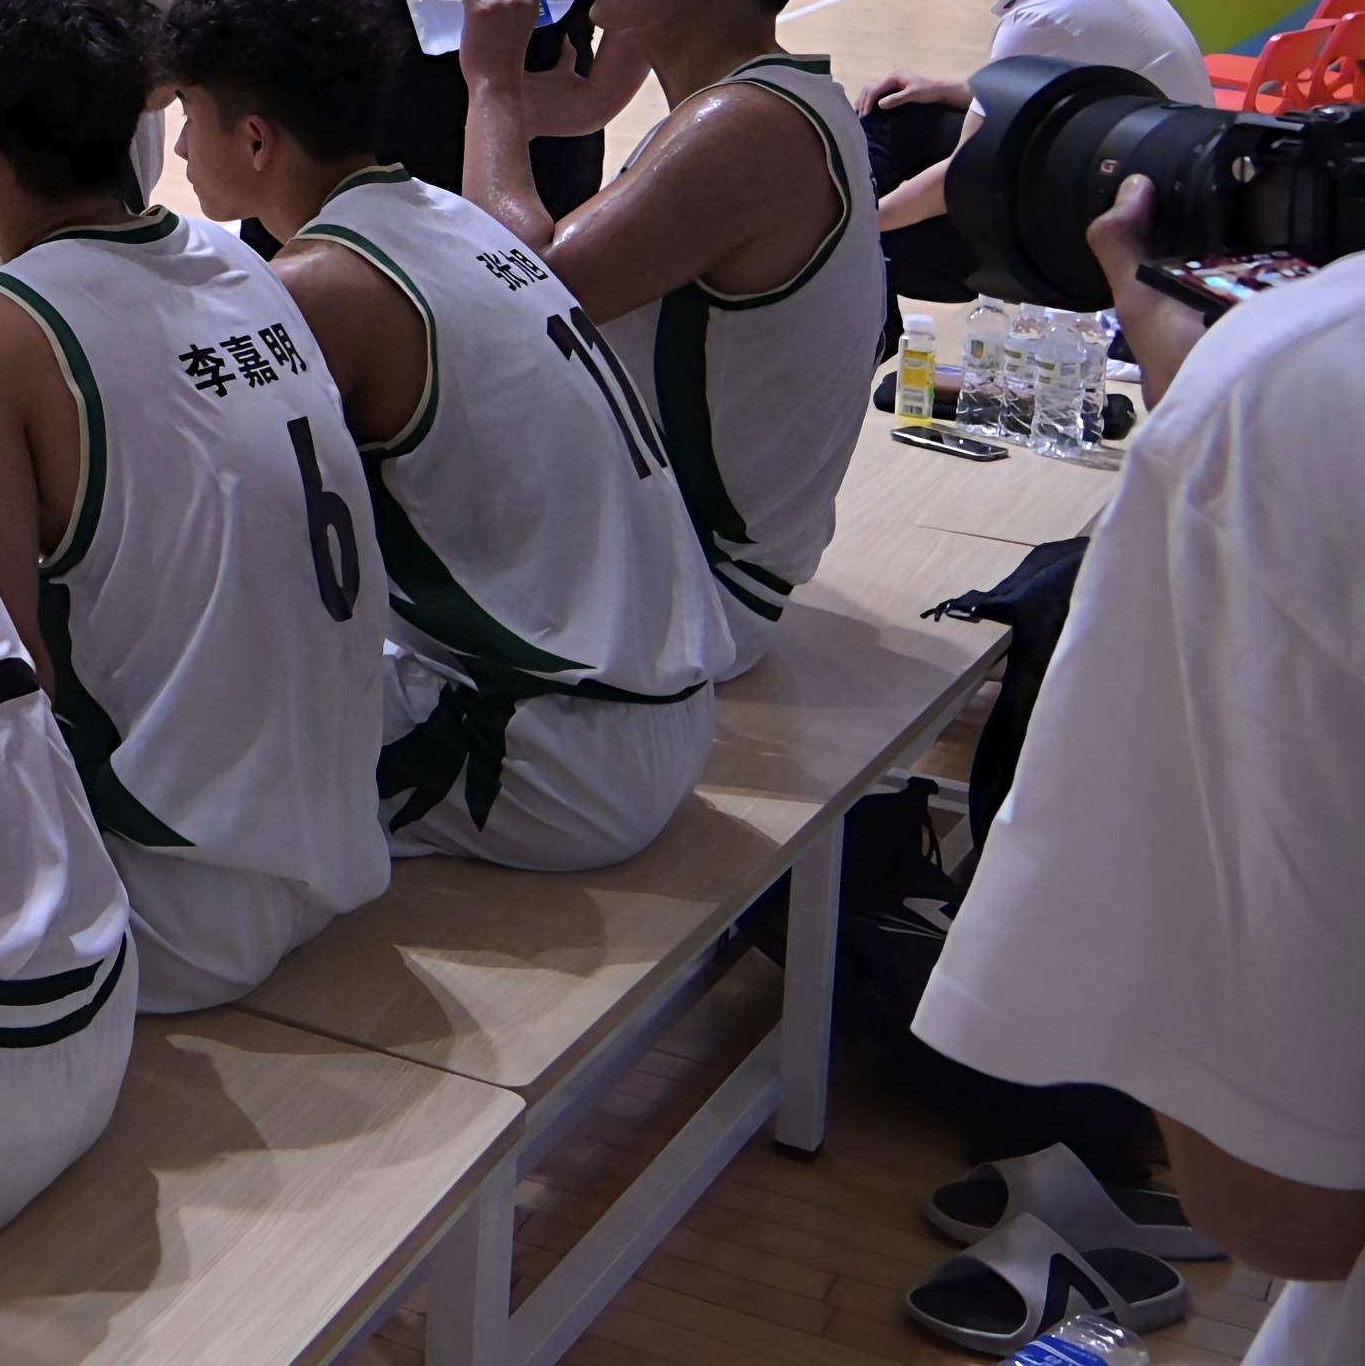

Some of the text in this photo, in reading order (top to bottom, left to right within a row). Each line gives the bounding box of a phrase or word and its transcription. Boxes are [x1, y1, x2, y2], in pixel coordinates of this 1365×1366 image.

[179, 322, 308, 399] 李嘉明
[546, 306, 668, 480] 11
[286, 415, 361, 623] 6
